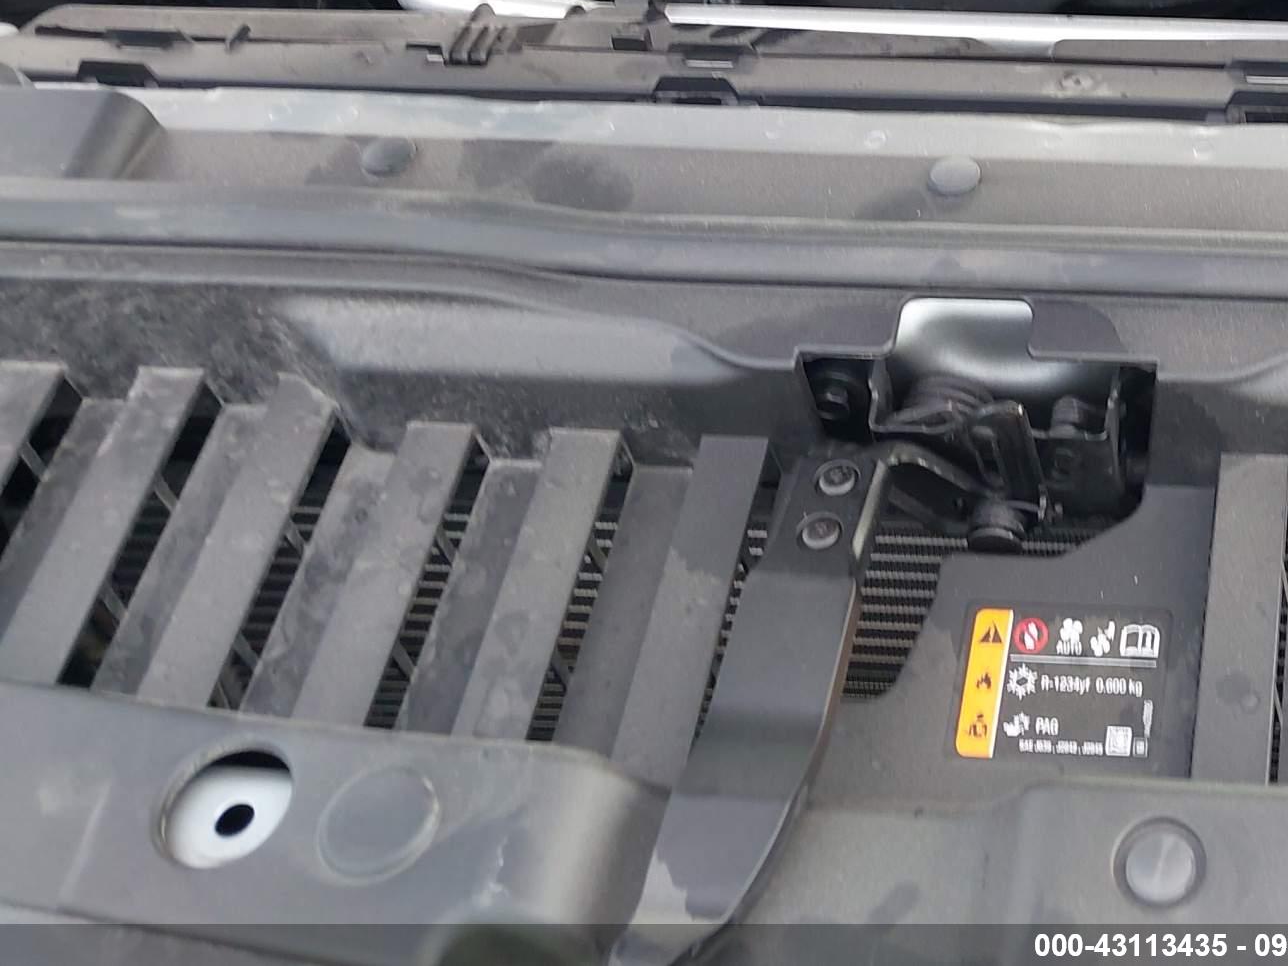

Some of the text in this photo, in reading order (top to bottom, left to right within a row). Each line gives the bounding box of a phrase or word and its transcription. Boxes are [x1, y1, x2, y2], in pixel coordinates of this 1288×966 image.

[1056, 640, 1082, 656] AUTO
[1040, 674, 1143, 698] R-1234yf 0.600 kg
